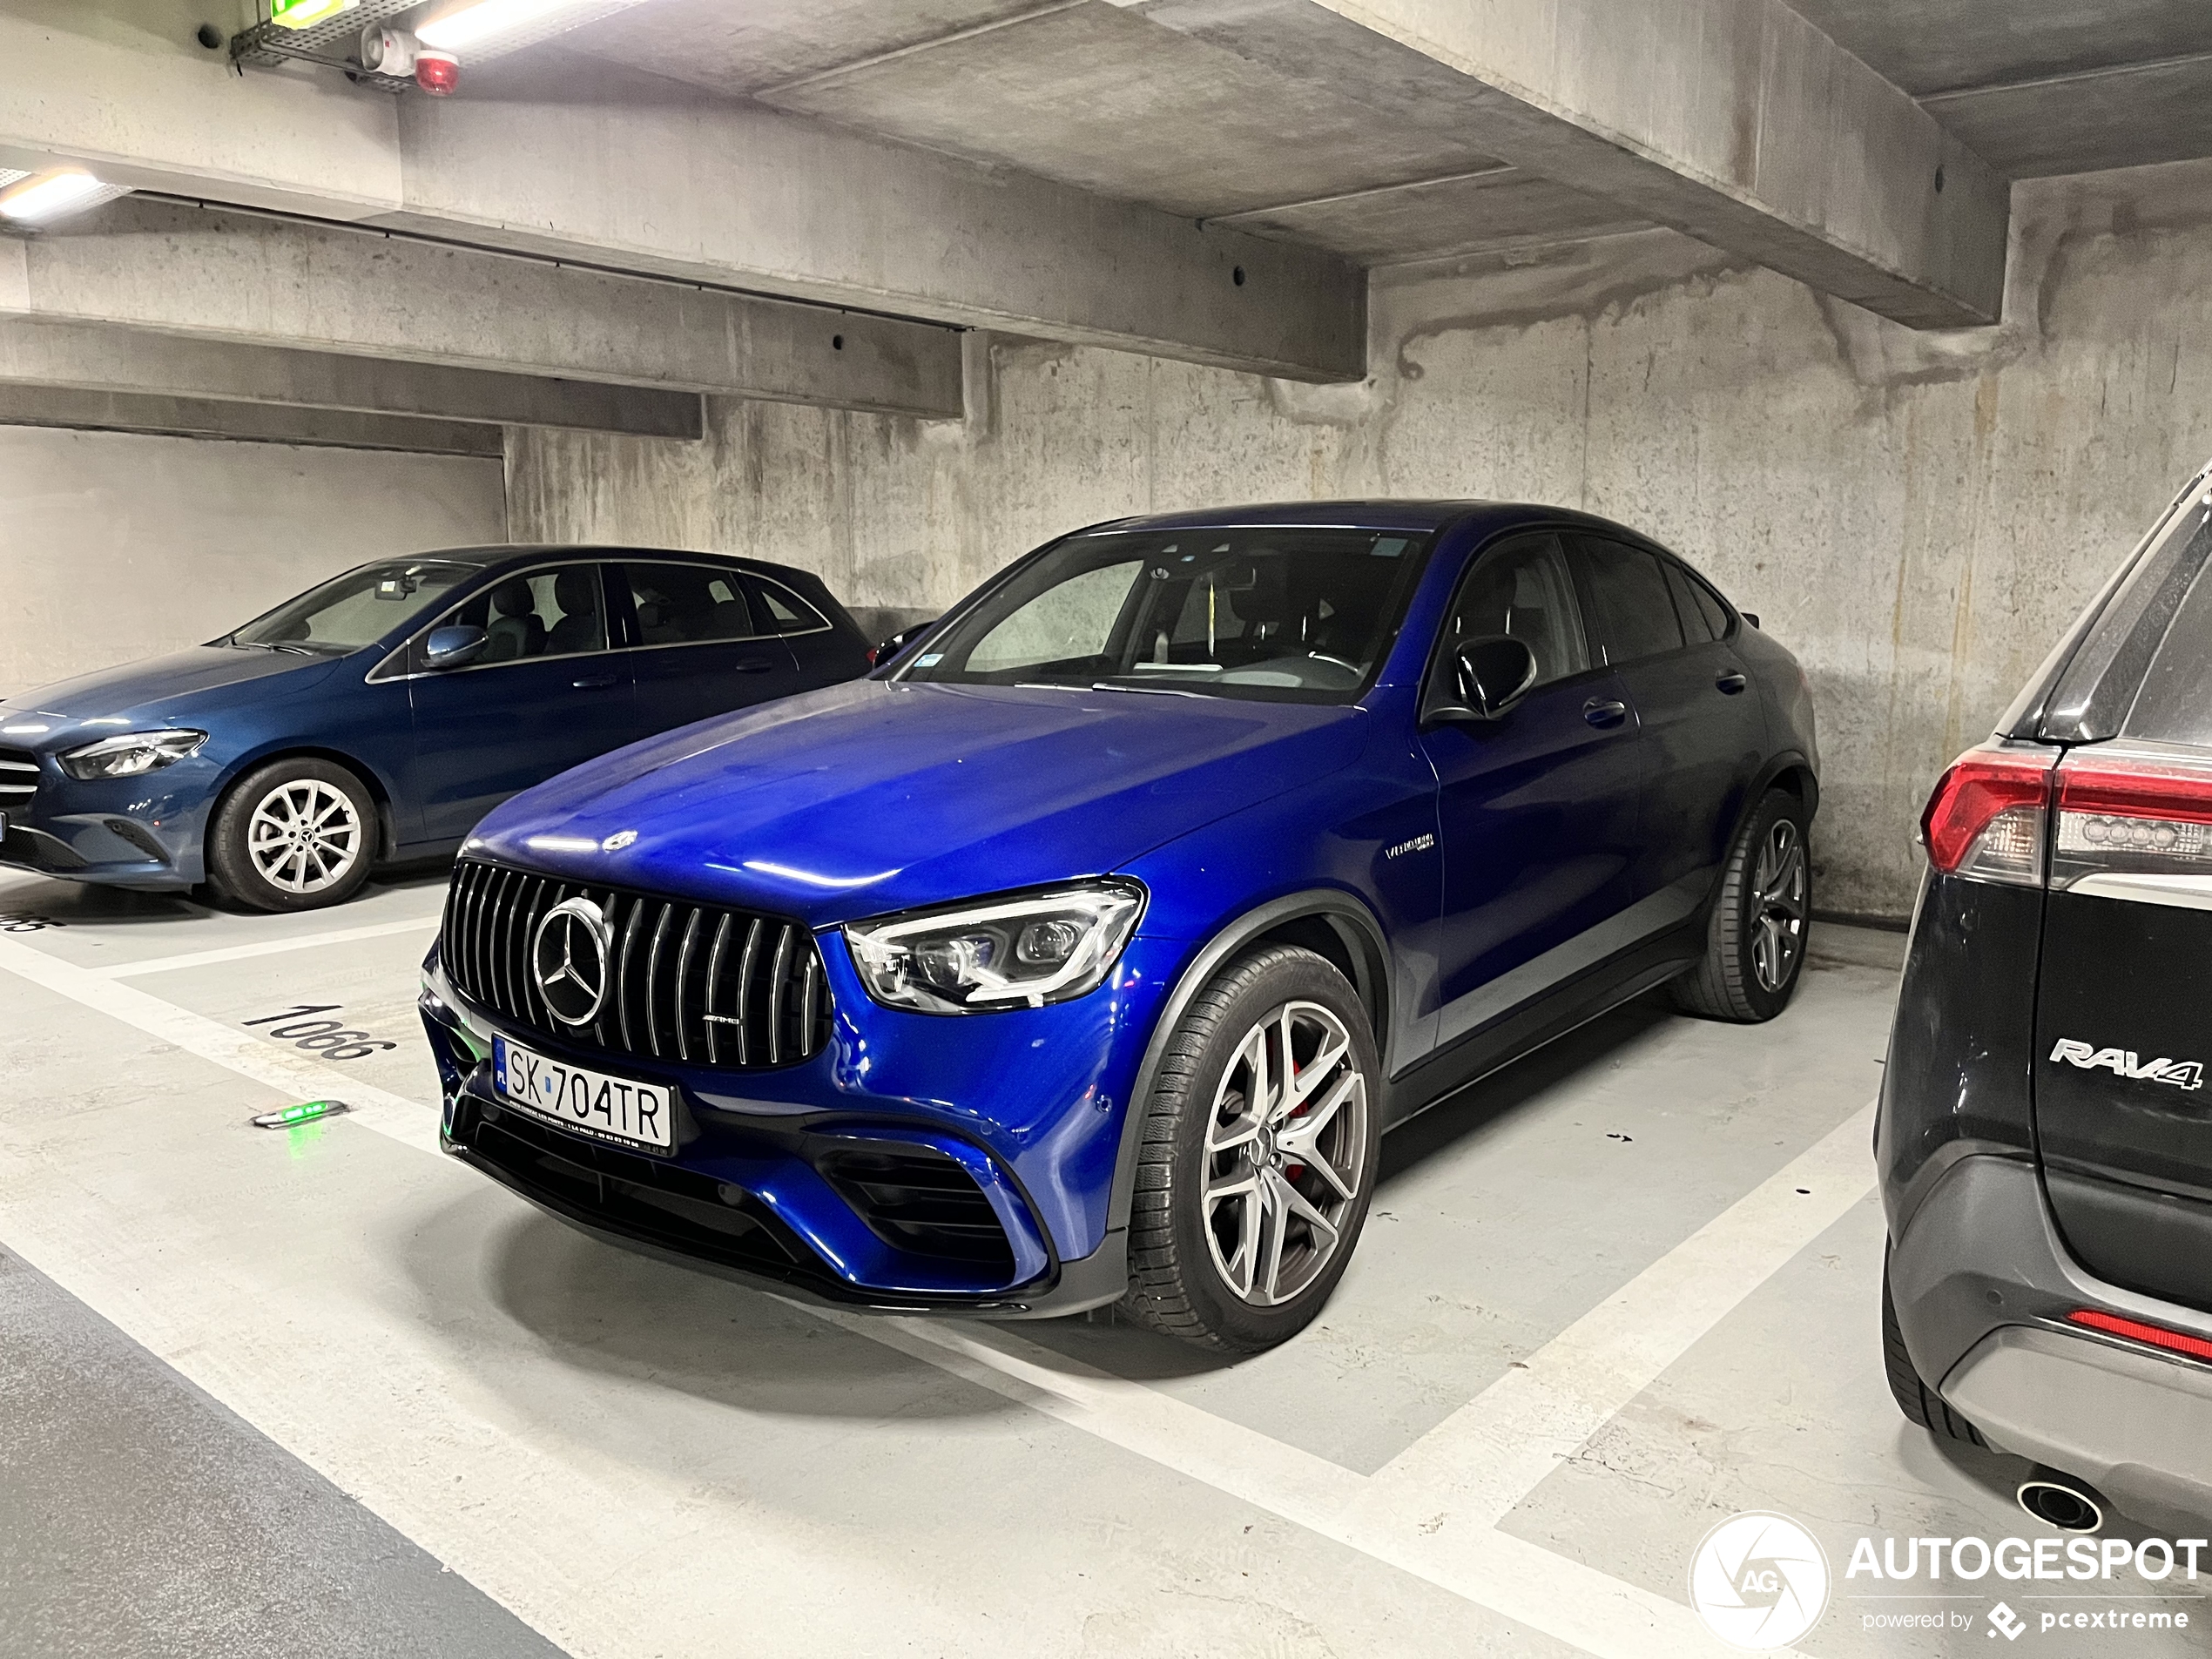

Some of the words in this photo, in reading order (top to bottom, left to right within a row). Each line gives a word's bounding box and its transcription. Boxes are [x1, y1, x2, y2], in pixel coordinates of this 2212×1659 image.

[241, 1005, 397, 1060] 1066
[497, 1070, 506, 1085] PL
[2049, 1038, 2203, 1090] RAV4
[511, 1050, 542, 1104] SK
[552, 1065, 660, 1139] 704TR
